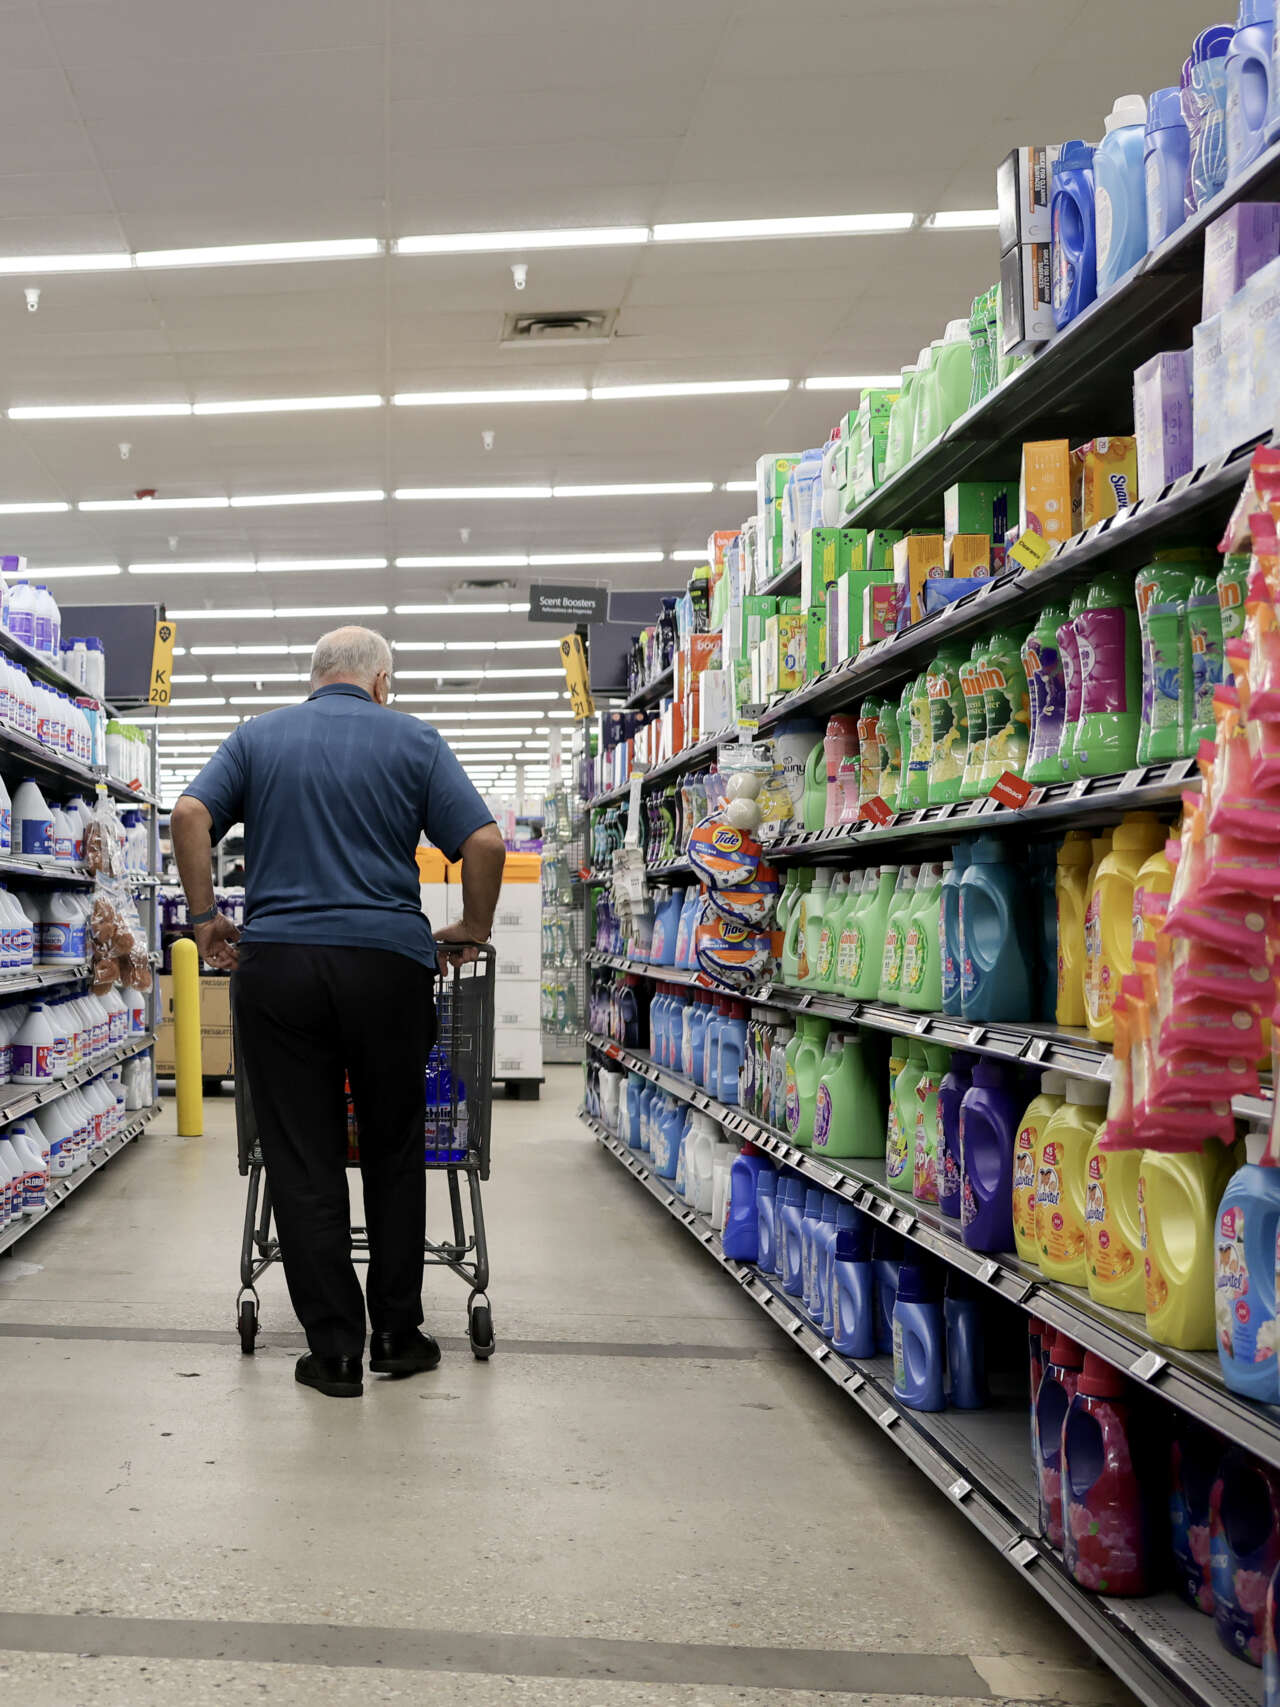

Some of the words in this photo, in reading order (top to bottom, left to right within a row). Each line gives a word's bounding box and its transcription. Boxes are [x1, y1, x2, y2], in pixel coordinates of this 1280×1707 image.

[539, 595, 561, 606] Scent
[562, 597, 596, 608] Boosters
[155, 669, 167, 684] K
[151, 688, 168, 703] 20
[570, 682, 580, 698] K
[574, 701, 586, 716] 21
[713, 831, 740, 846] Tide
